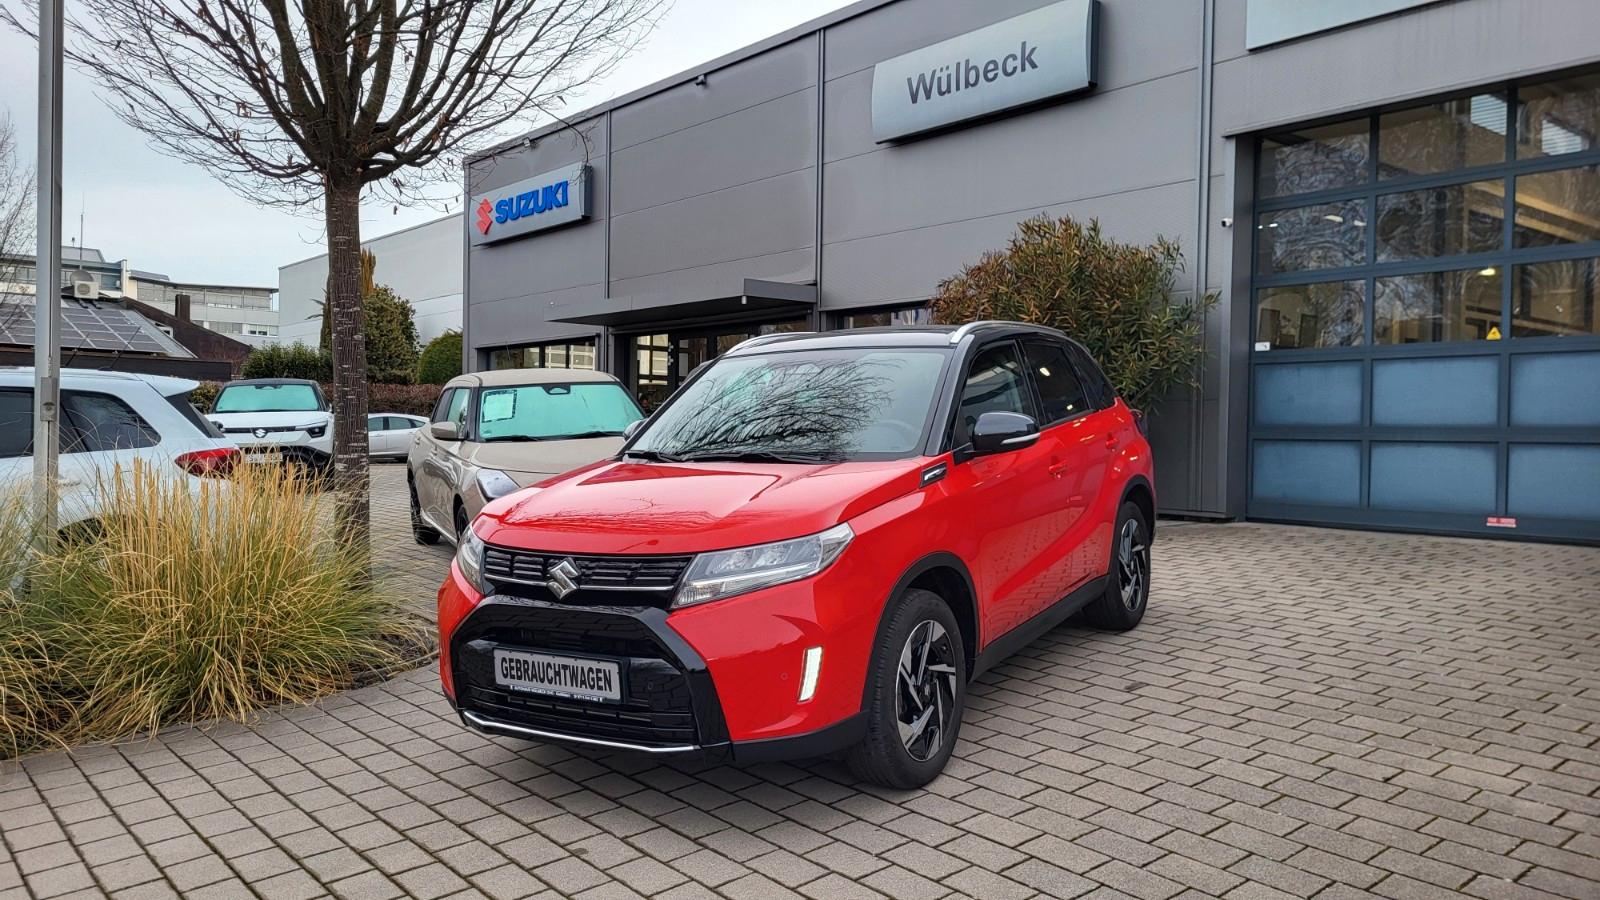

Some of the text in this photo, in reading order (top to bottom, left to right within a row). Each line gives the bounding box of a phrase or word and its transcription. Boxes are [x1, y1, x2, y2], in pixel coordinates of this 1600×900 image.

[907, 41, 1038, 104] Wülbeck
[495, 180, 569, 224] SUZUKI
[500, 656, 613, 692] GEBRAUCHTWAGEN
